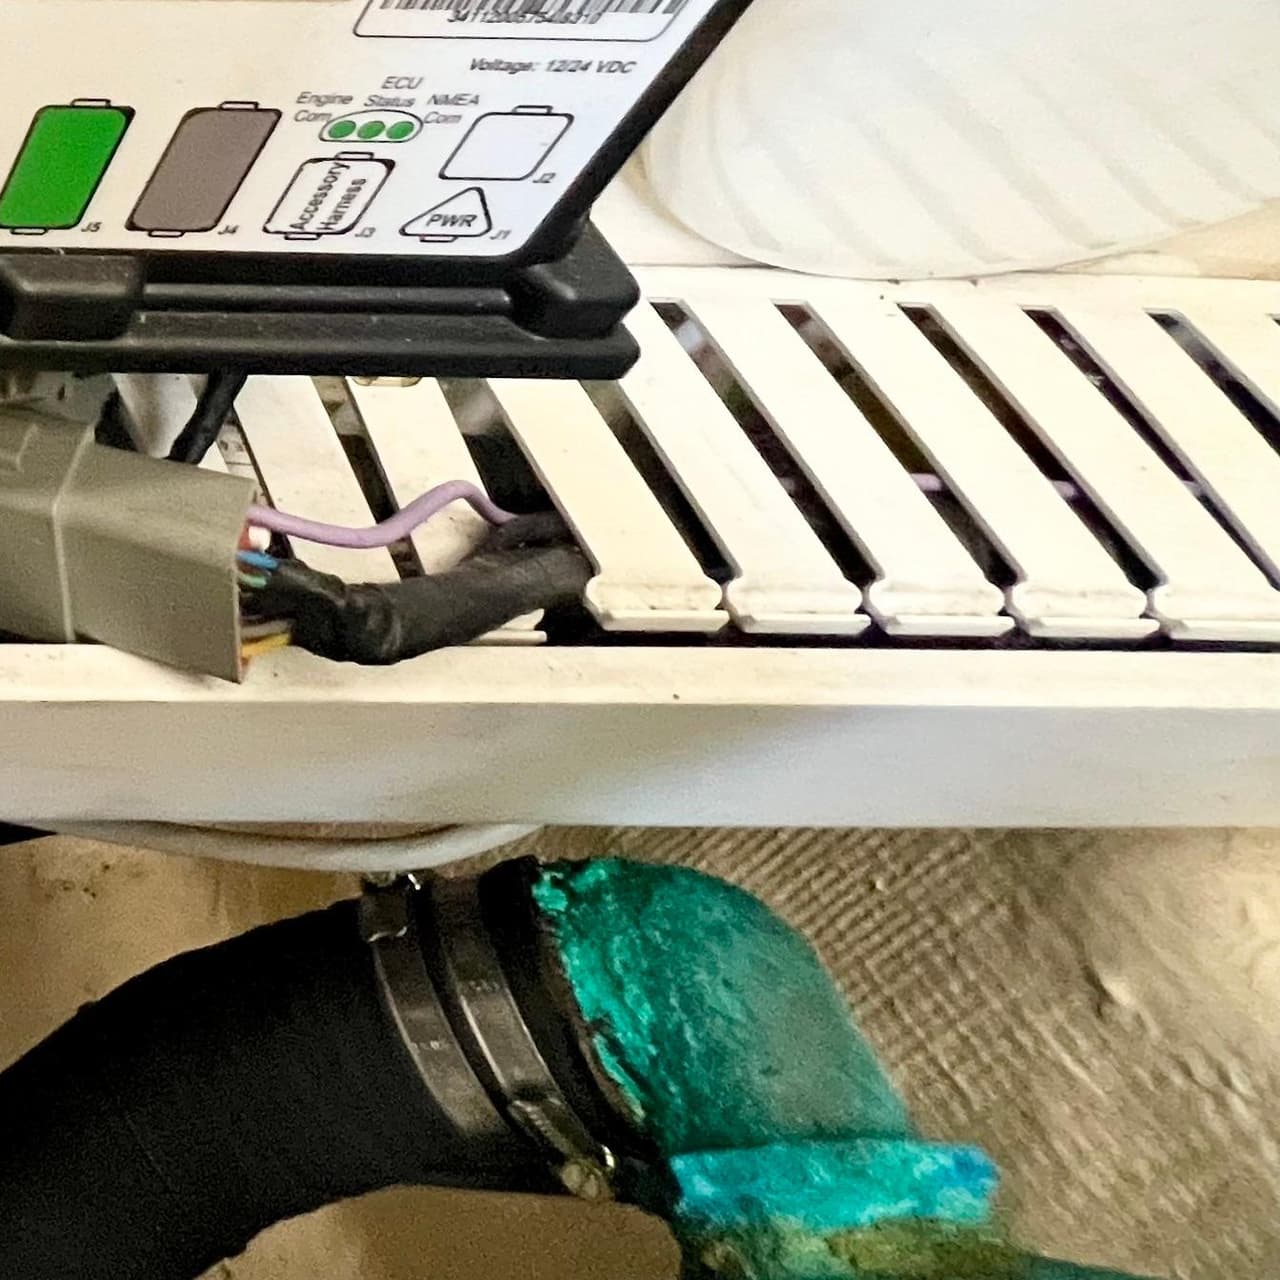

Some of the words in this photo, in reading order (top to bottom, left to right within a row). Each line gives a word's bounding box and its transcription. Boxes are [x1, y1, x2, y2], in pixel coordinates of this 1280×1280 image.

[469, 57, 540, 74] Voltage:
[545, 59, 592, 73] 12/24
[595, 60, 638, 74] VDC
[380, 75, 425, 90] ECU
[295, 91, 354, 106] Engine
[363, 94, 417, 108] Status
[425, 93, 481, 106] NMEA
[293, 109, 333, 123] Com
[422, 111, 463, 124] Com
[531, 172, 557, 184] J2
[289, 162, 350, 231] Accessory
[316, 177, 368, 231] Harness
[80, 220, 102, 233] J5
[425, 213, 478, 228] PWR
[217, 224, 239, 236] J4
[353, 226, 377, 239] J3
[488, 228, 513, 241] J1
